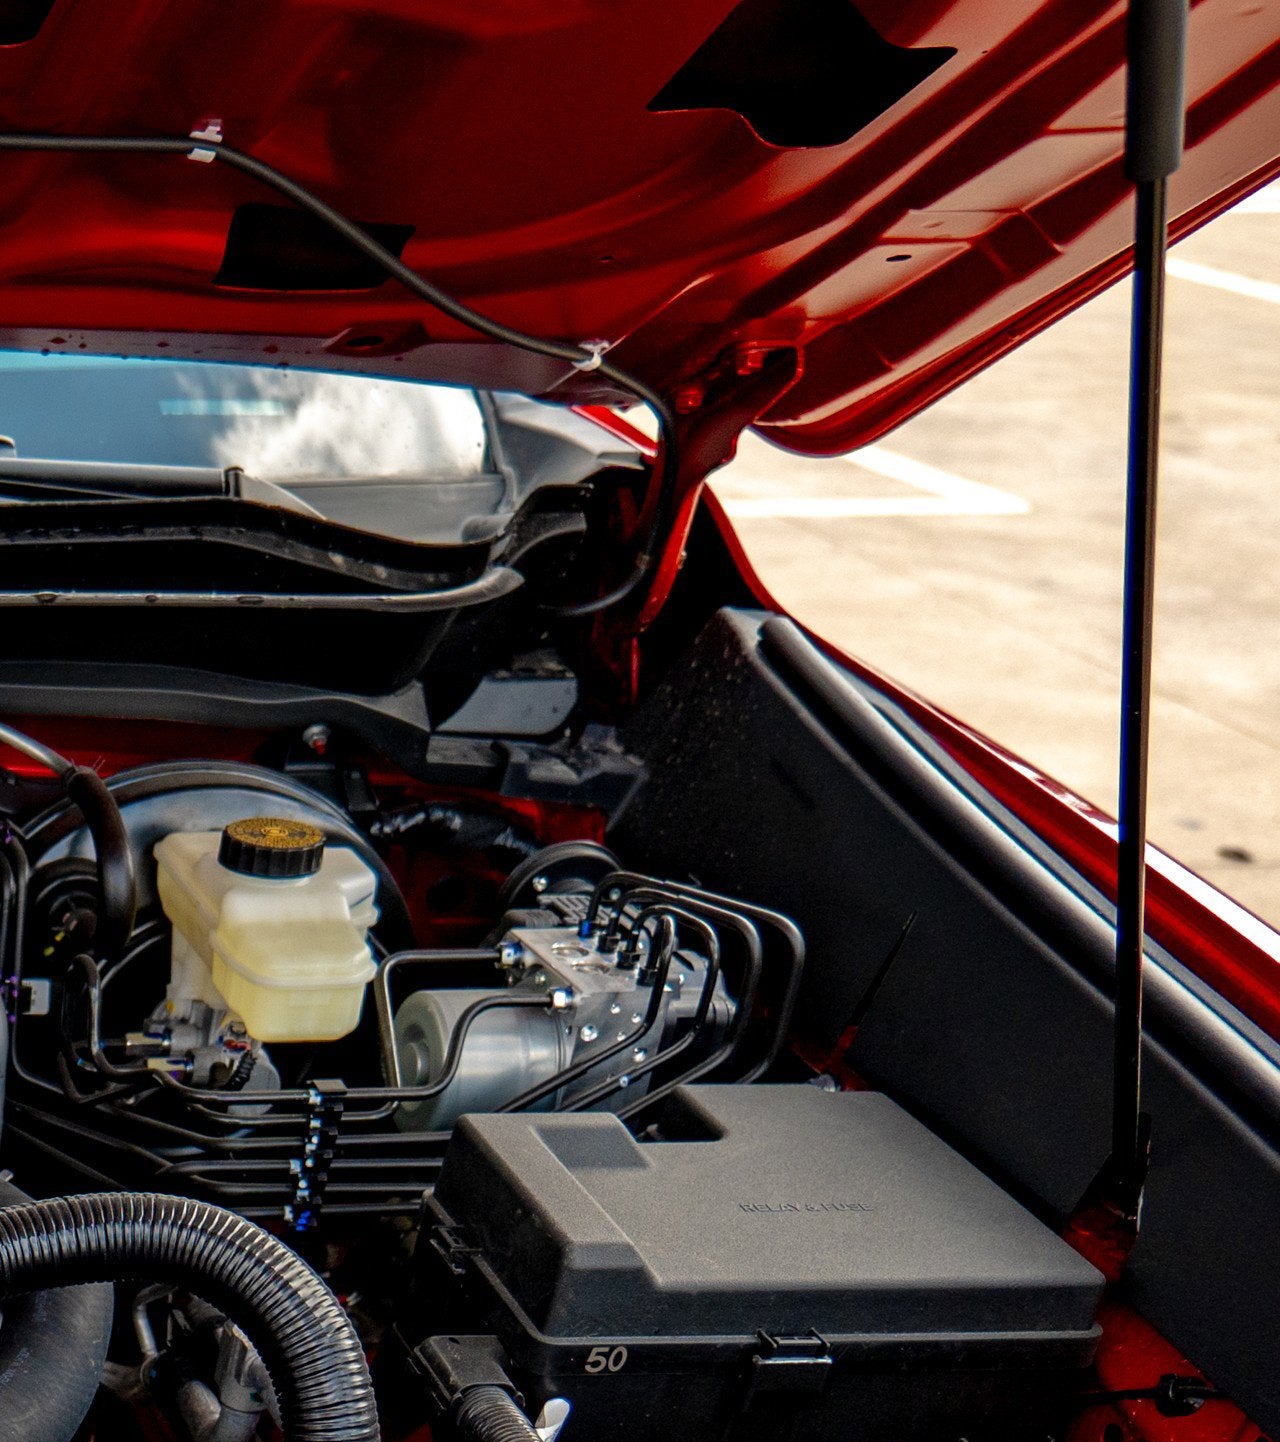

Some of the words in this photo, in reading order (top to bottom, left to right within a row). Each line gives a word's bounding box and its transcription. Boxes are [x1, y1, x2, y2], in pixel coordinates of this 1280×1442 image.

[740, 1202, 800, 1213] RELAY
[821, 1202, 874, 1212] FUSE
[584, 1346, 628, 1373] 50
